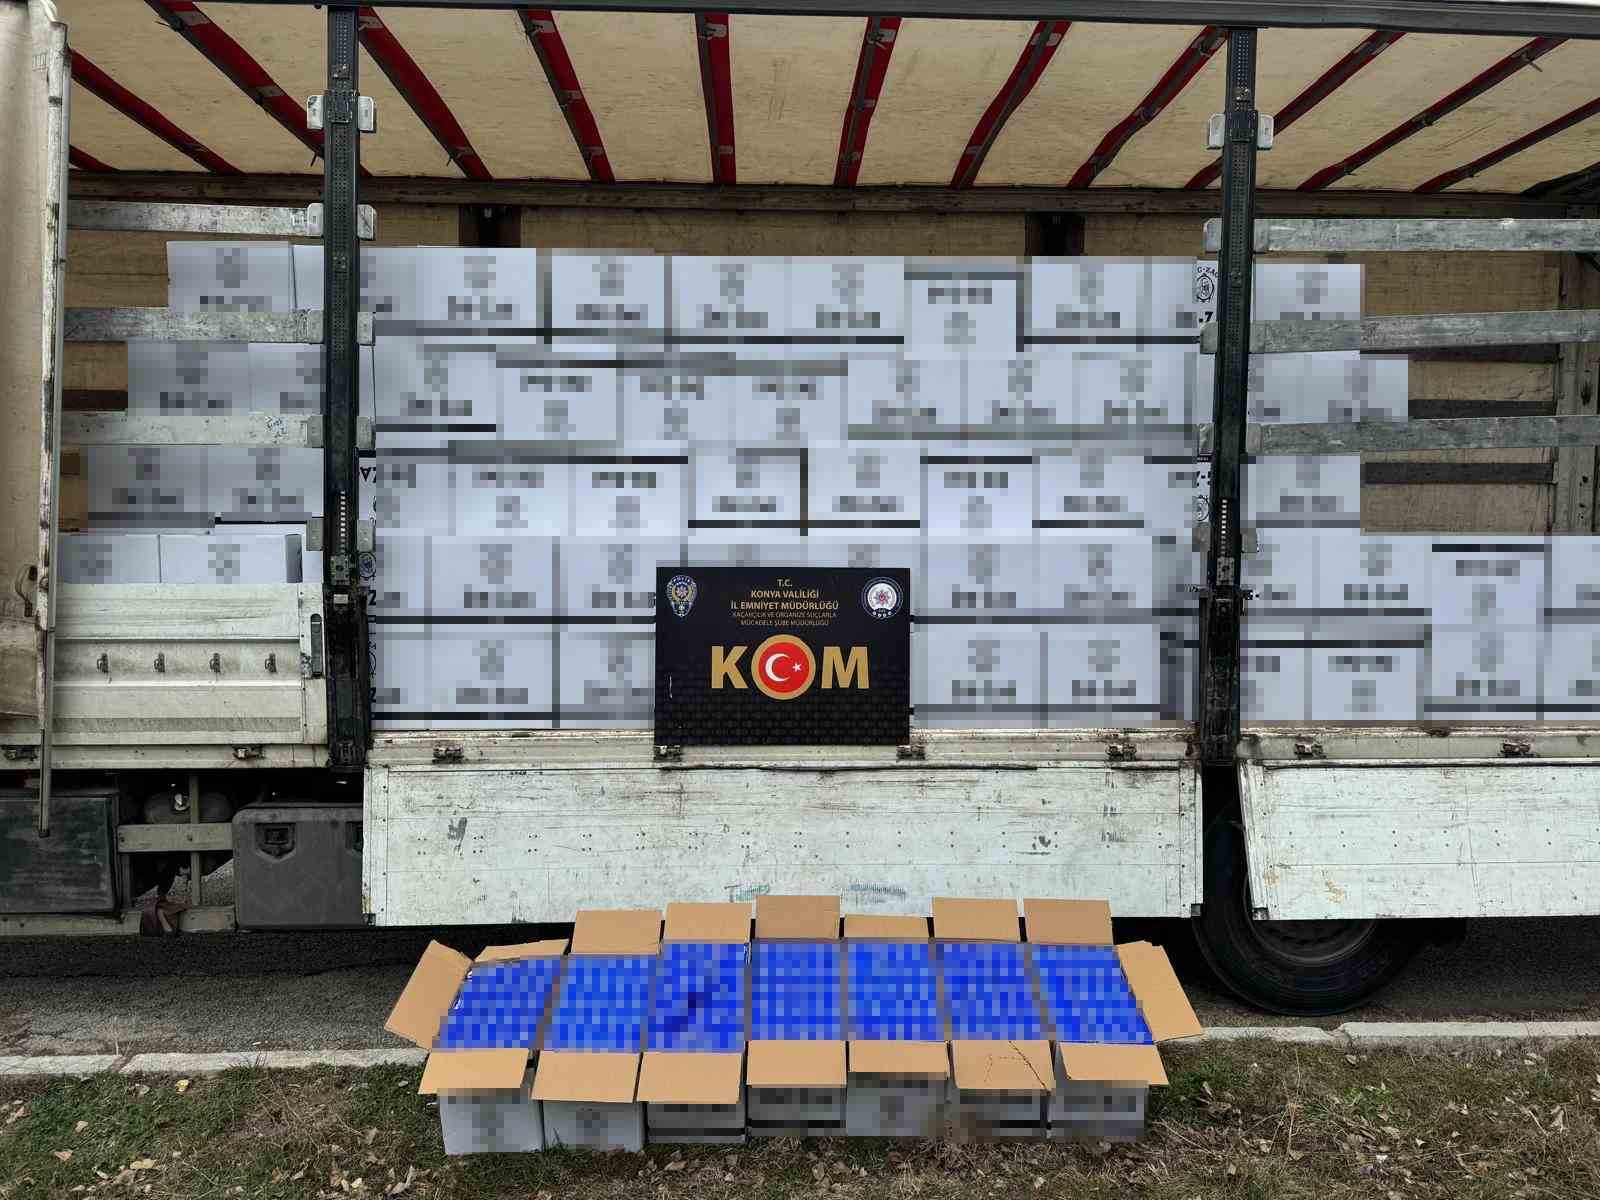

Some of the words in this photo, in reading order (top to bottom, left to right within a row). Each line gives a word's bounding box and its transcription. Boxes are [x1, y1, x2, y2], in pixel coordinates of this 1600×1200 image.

[777, 579, 793, 588] T.C.
[751, 590, 781, 599] KONYA
[730, 600, 739, 610] İL
[740, 600, 780, 610] EMNİYET
[781, 600, 839, 610] MÜDÜRLÜĞÜ
